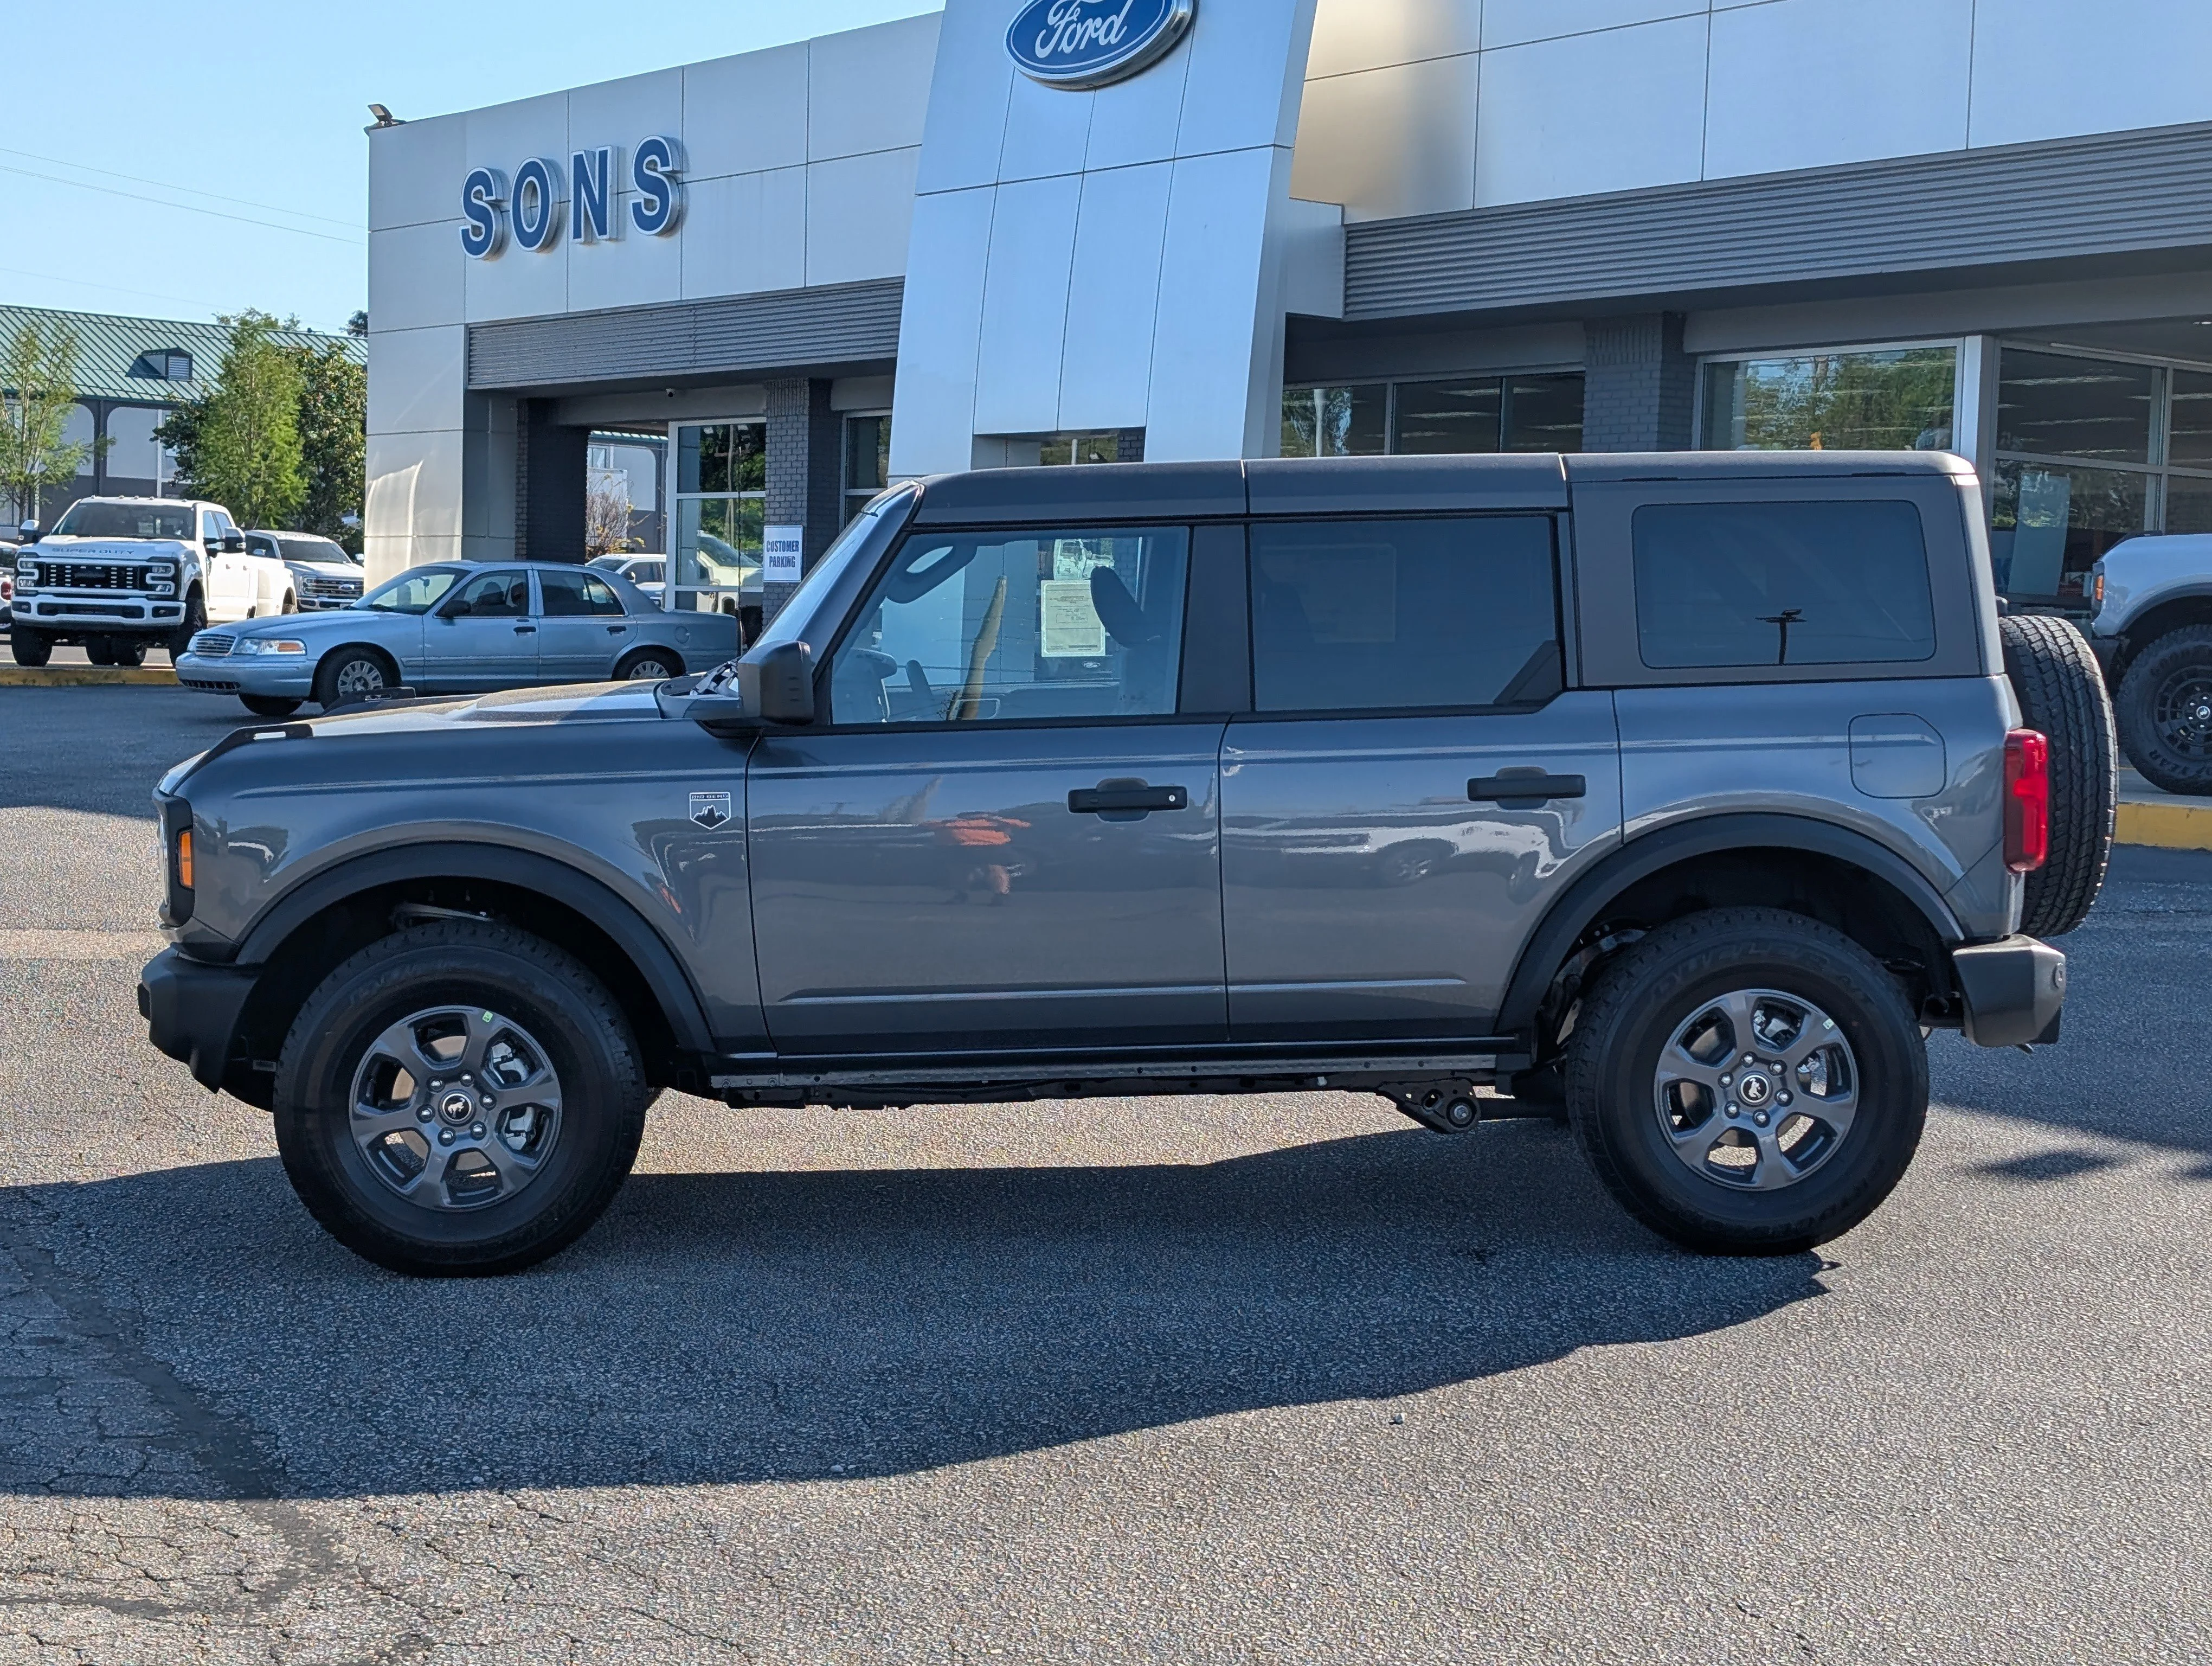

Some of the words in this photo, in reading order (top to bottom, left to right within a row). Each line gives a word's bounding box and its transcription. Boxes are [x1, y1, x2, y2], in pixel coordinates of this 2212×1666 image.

[1034, 0, 1134, 58] Ford
[459, 134, 681, 260] SONS
[766, 540, 800, 553] CUSTOMER
[769, 555, 796, 568] PARKING
